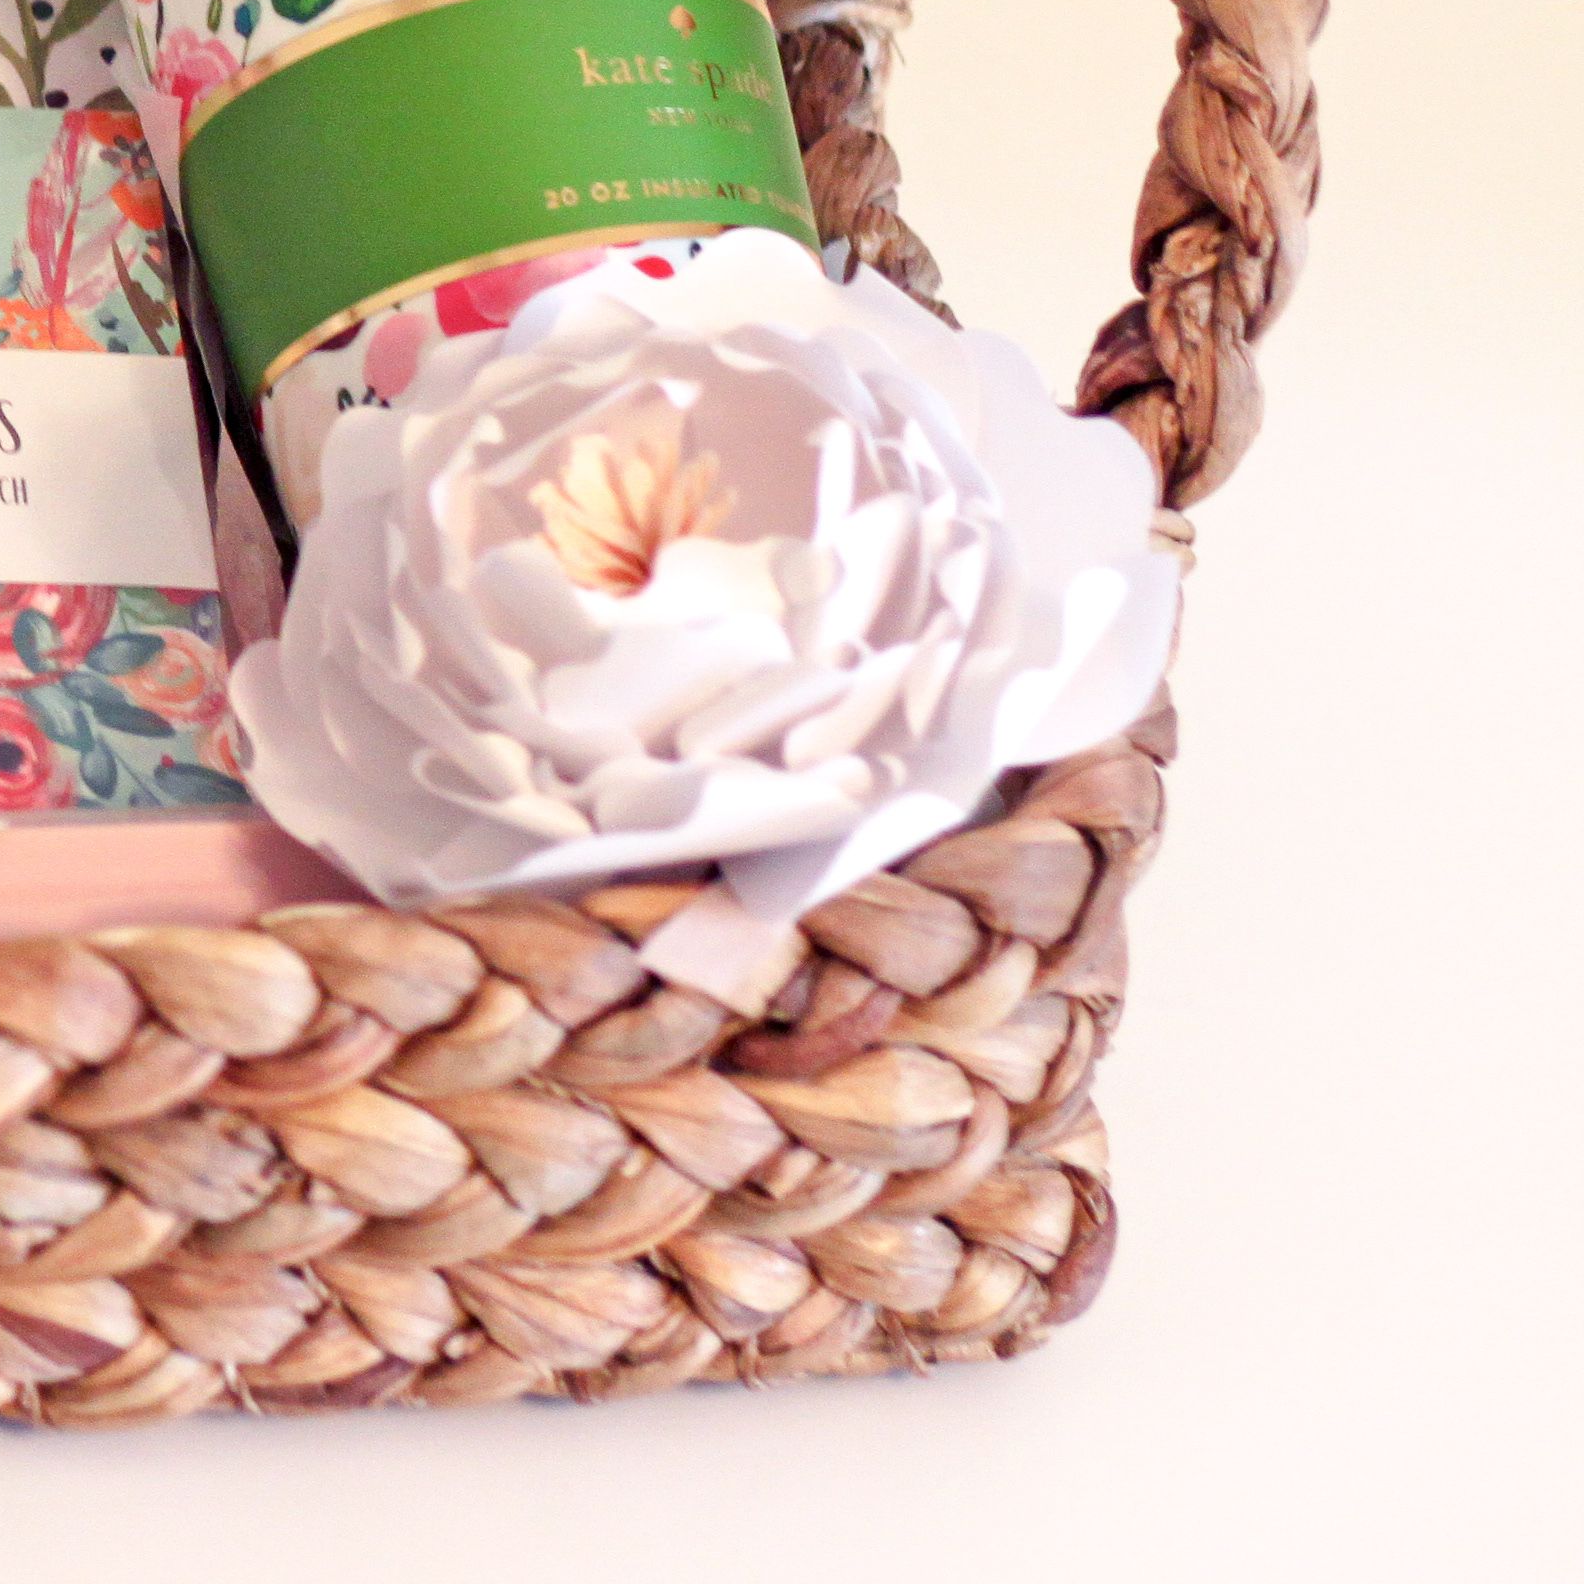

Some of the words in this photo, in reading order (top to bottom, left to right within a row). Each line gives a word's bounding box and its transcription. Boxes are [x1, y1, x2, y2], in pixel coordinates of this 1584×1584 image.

[572, 47, 673, 86] kate
[543, 185, 580, 210] 20
[589, 178, 631, 203] OZ
